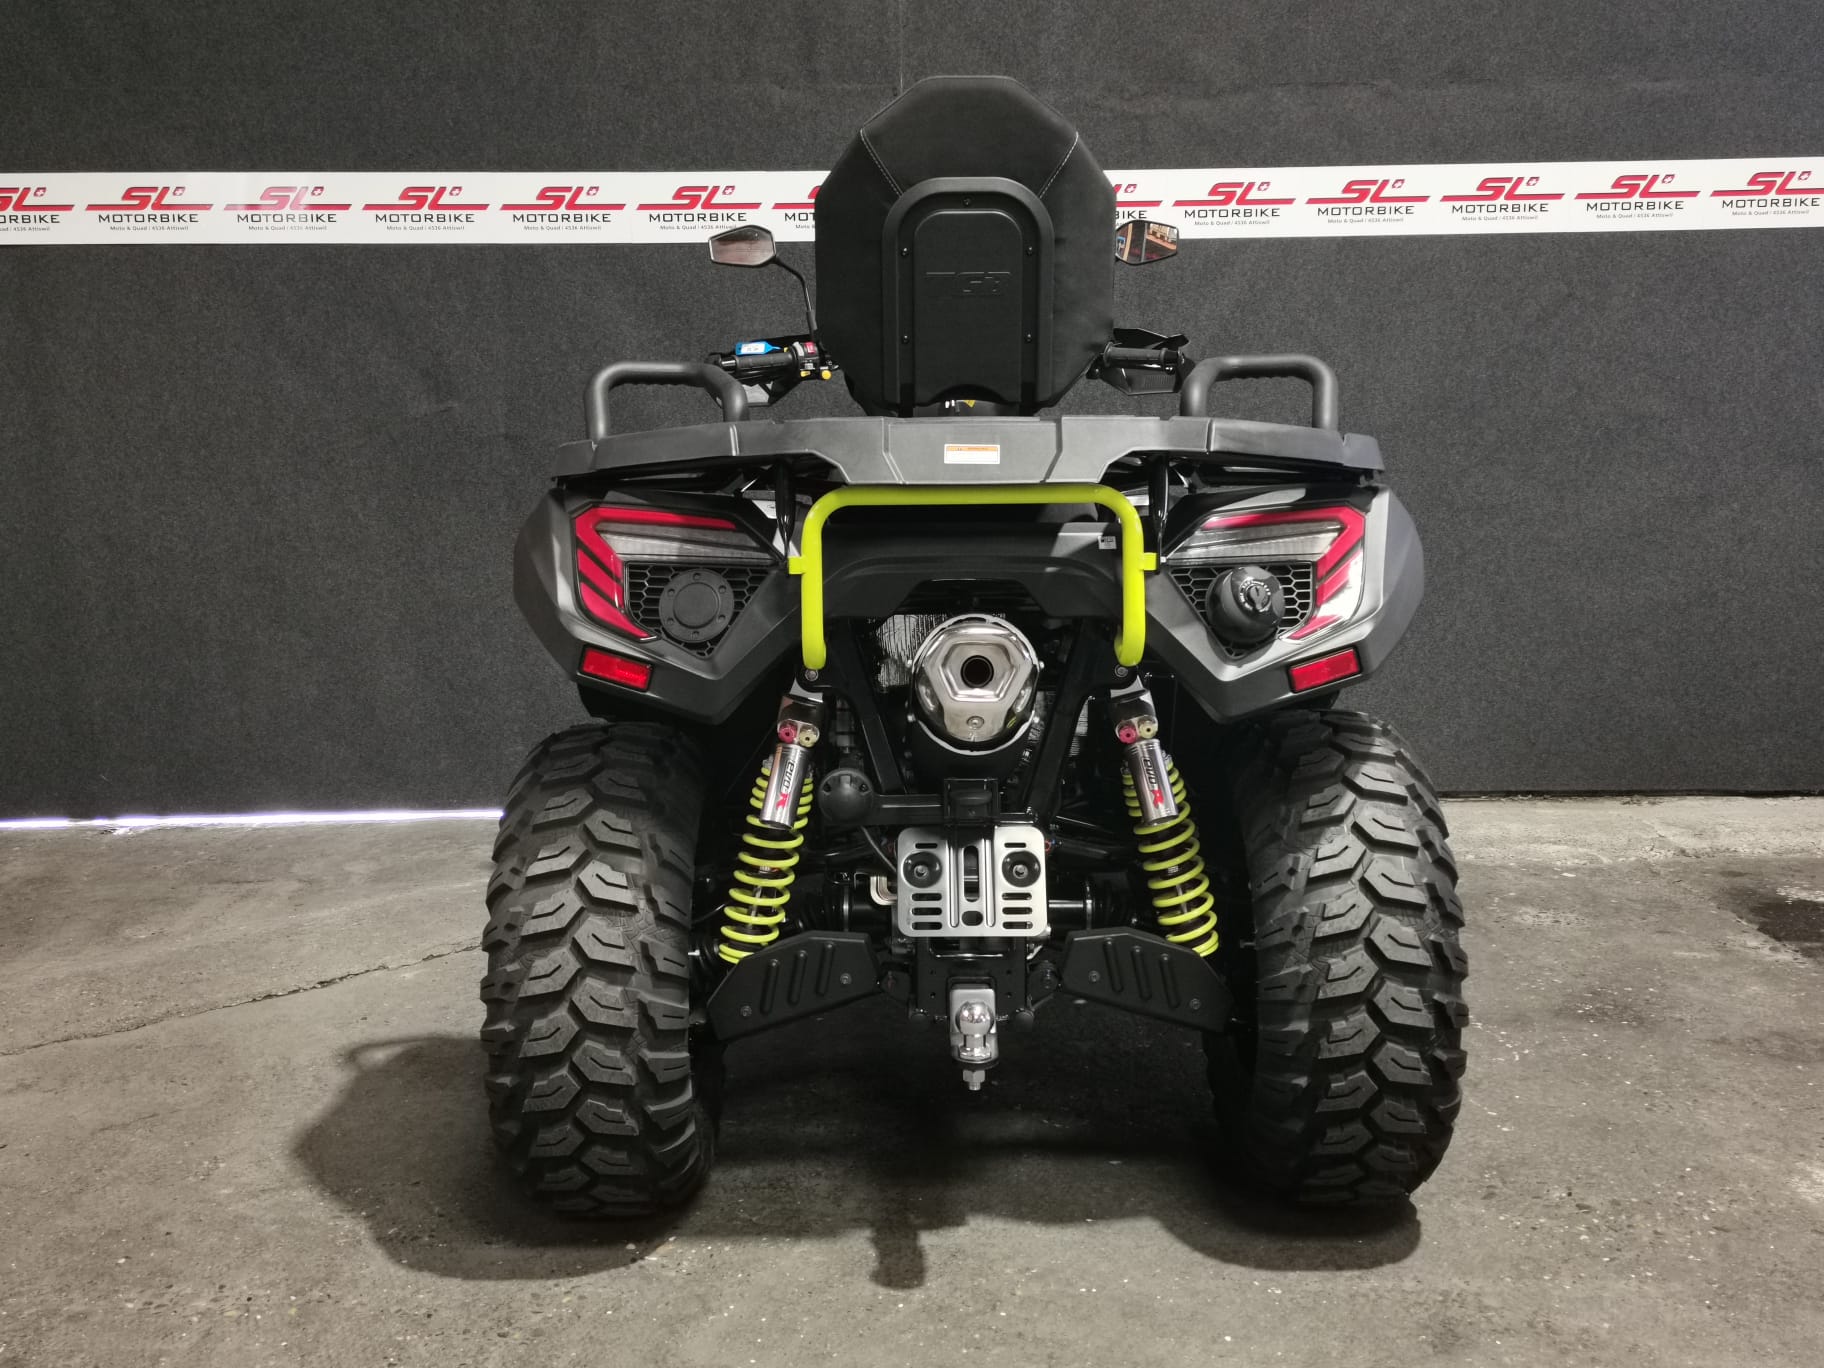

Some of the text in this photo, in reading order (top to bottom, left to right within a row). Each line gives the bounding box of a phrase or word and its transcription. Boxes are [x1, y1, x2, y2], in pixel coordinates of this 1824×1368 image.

[1586, 200, 1684, 211] MOTORBIKE
[1722, 198, 1821, 208] MOTORBIKE
[1184, 208, 1280, 218] MOTORBIKE
[1318, 206, 1415, 216] MOTORBIKE
[1452, 203, 1549, 214] MOTORBIKE
[0, 214, 60, 223] ORBIKE
[98, 214, 199, 222] MOTORBIKE
[237, 214, 336, 222] MOTORBIKE
[376, 214, 475, 222] MOTORBIKE
[513, 214, 612, 222] MOTORBIKE
[649, 212, 747, 222] MOTORBIKE
